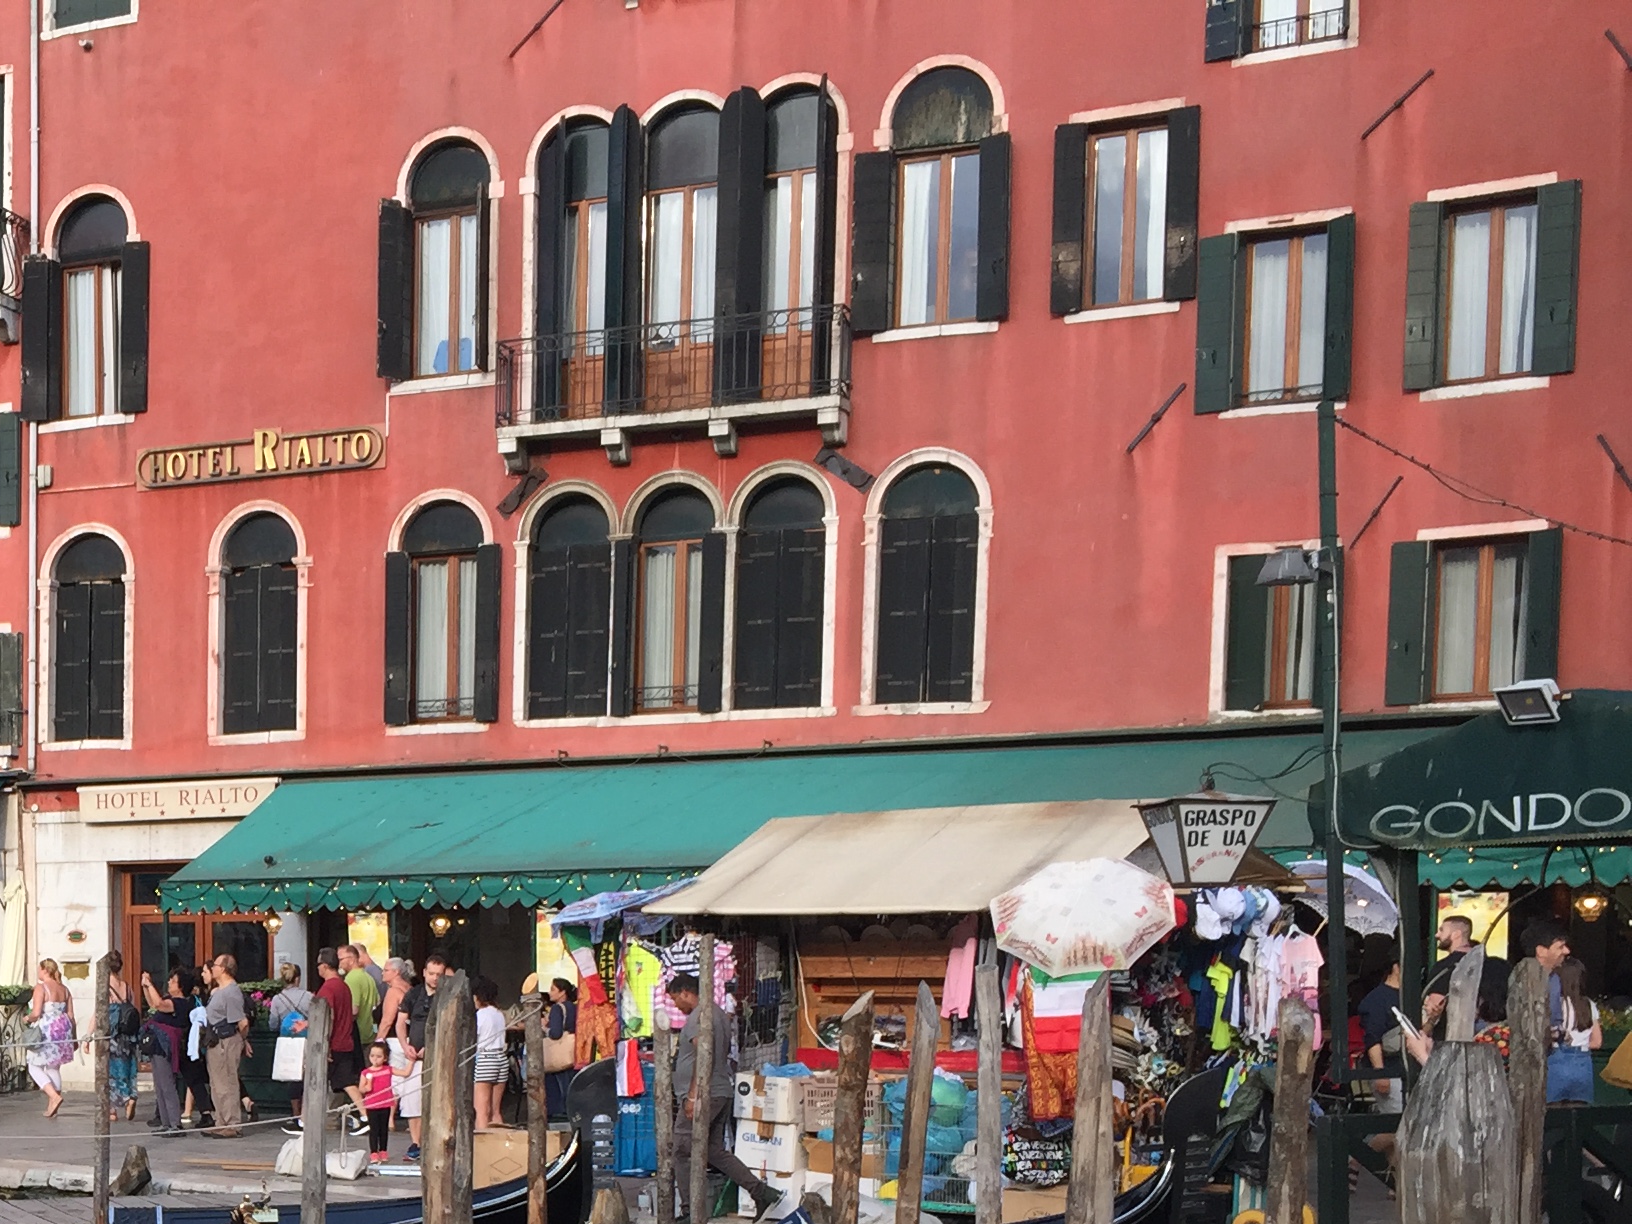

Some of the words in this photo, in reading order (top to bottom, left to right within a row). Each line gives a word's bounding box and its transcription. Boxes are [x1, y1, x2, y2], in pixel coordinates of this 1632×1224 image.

[149, 446, 240, 483] HOTEL
[254, 430, 372, 472] RIALTO
[96, 791, 165, 809] HOTEL
[179, 786, 259, 806] RIALTO
[1184, 809, 1257, 827] GRASPO
[1369, 788, 1631, 840] GONDO
[1187, 830, 1211, 847] DE
[1223, 829, 1247, 846] UA
